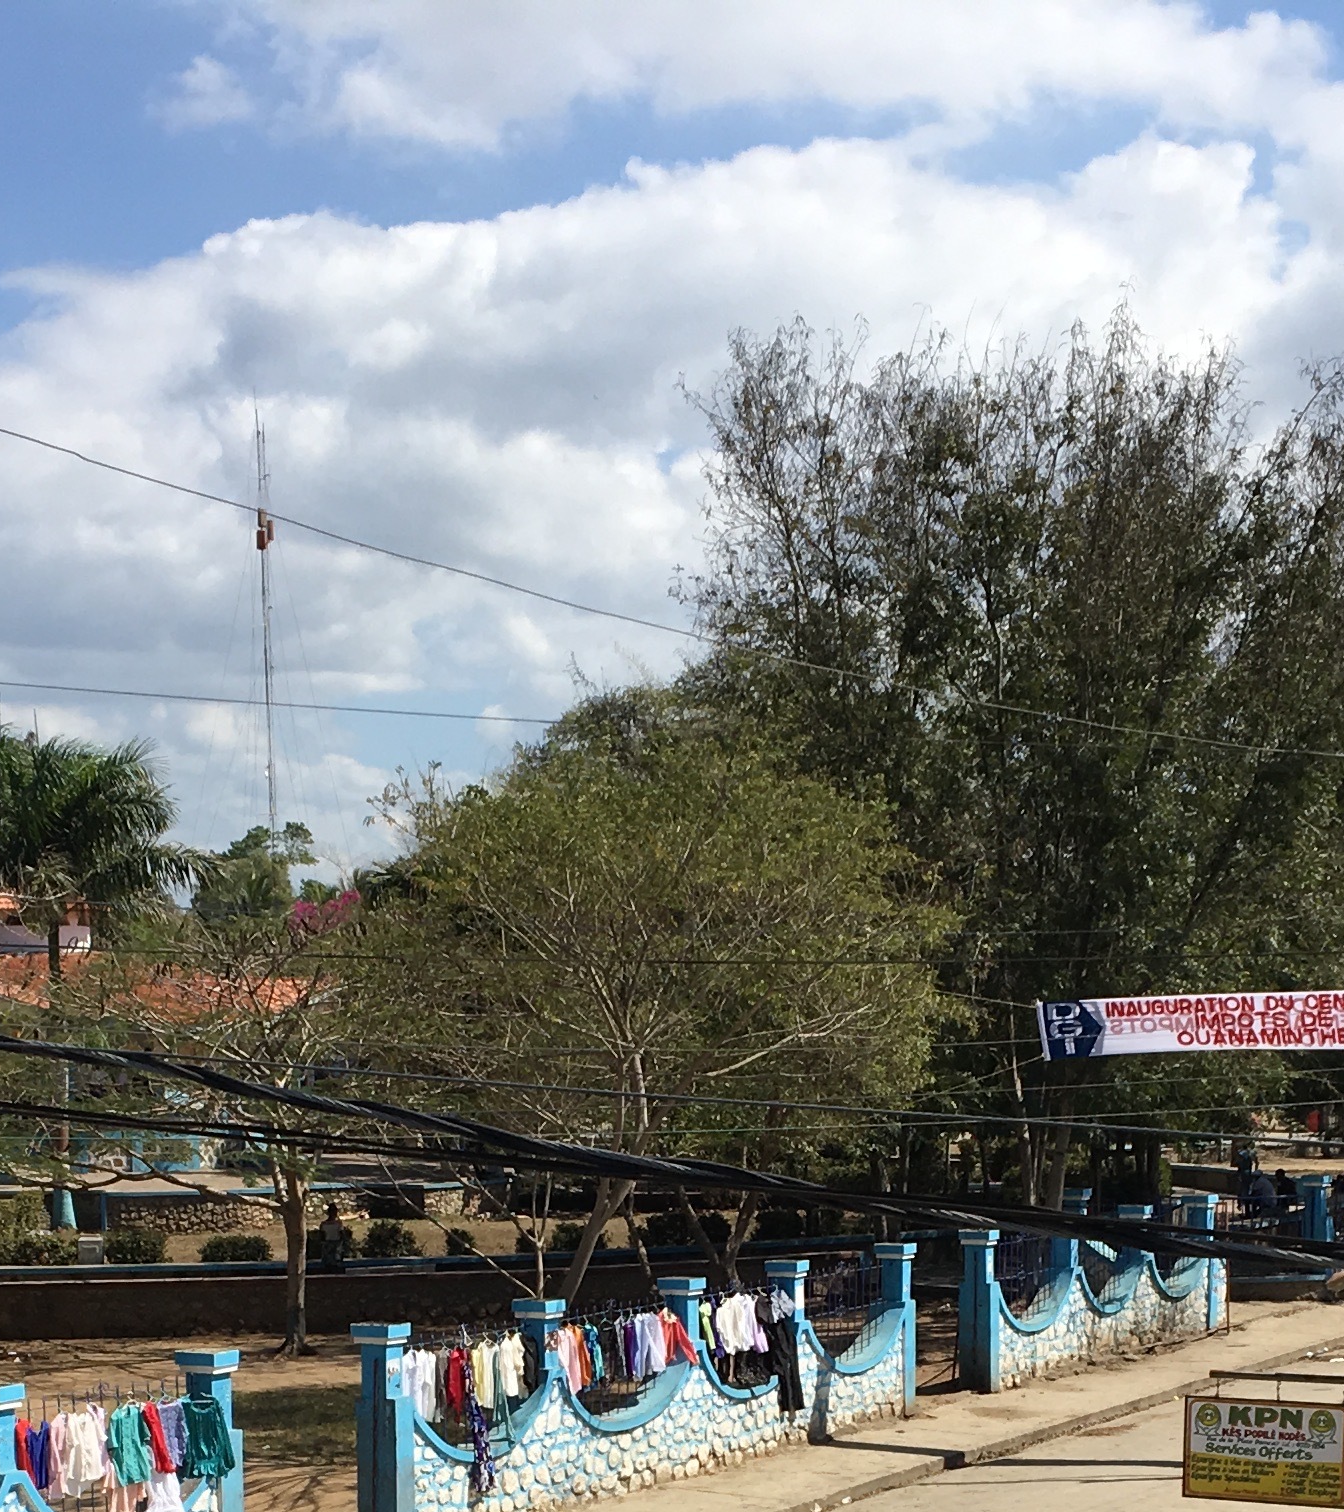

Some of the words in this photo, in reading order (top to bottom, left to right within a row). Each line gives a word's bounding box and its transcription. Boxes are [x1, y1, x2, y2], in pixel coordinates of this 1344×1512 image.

[1105, 996, 1255, 1018] INAUGURATION
[1266, 995, 1294, 1011] DU
[1195, 1011, 1289, 1029] IMPOTS
[1300, 1010, 1333, 1028] DE
[1228, 1405, 1303, 1430] KPN
[1205, 1442, 1256, 1457] Services
[1258, 1446, 1313, 1460] Offerts
